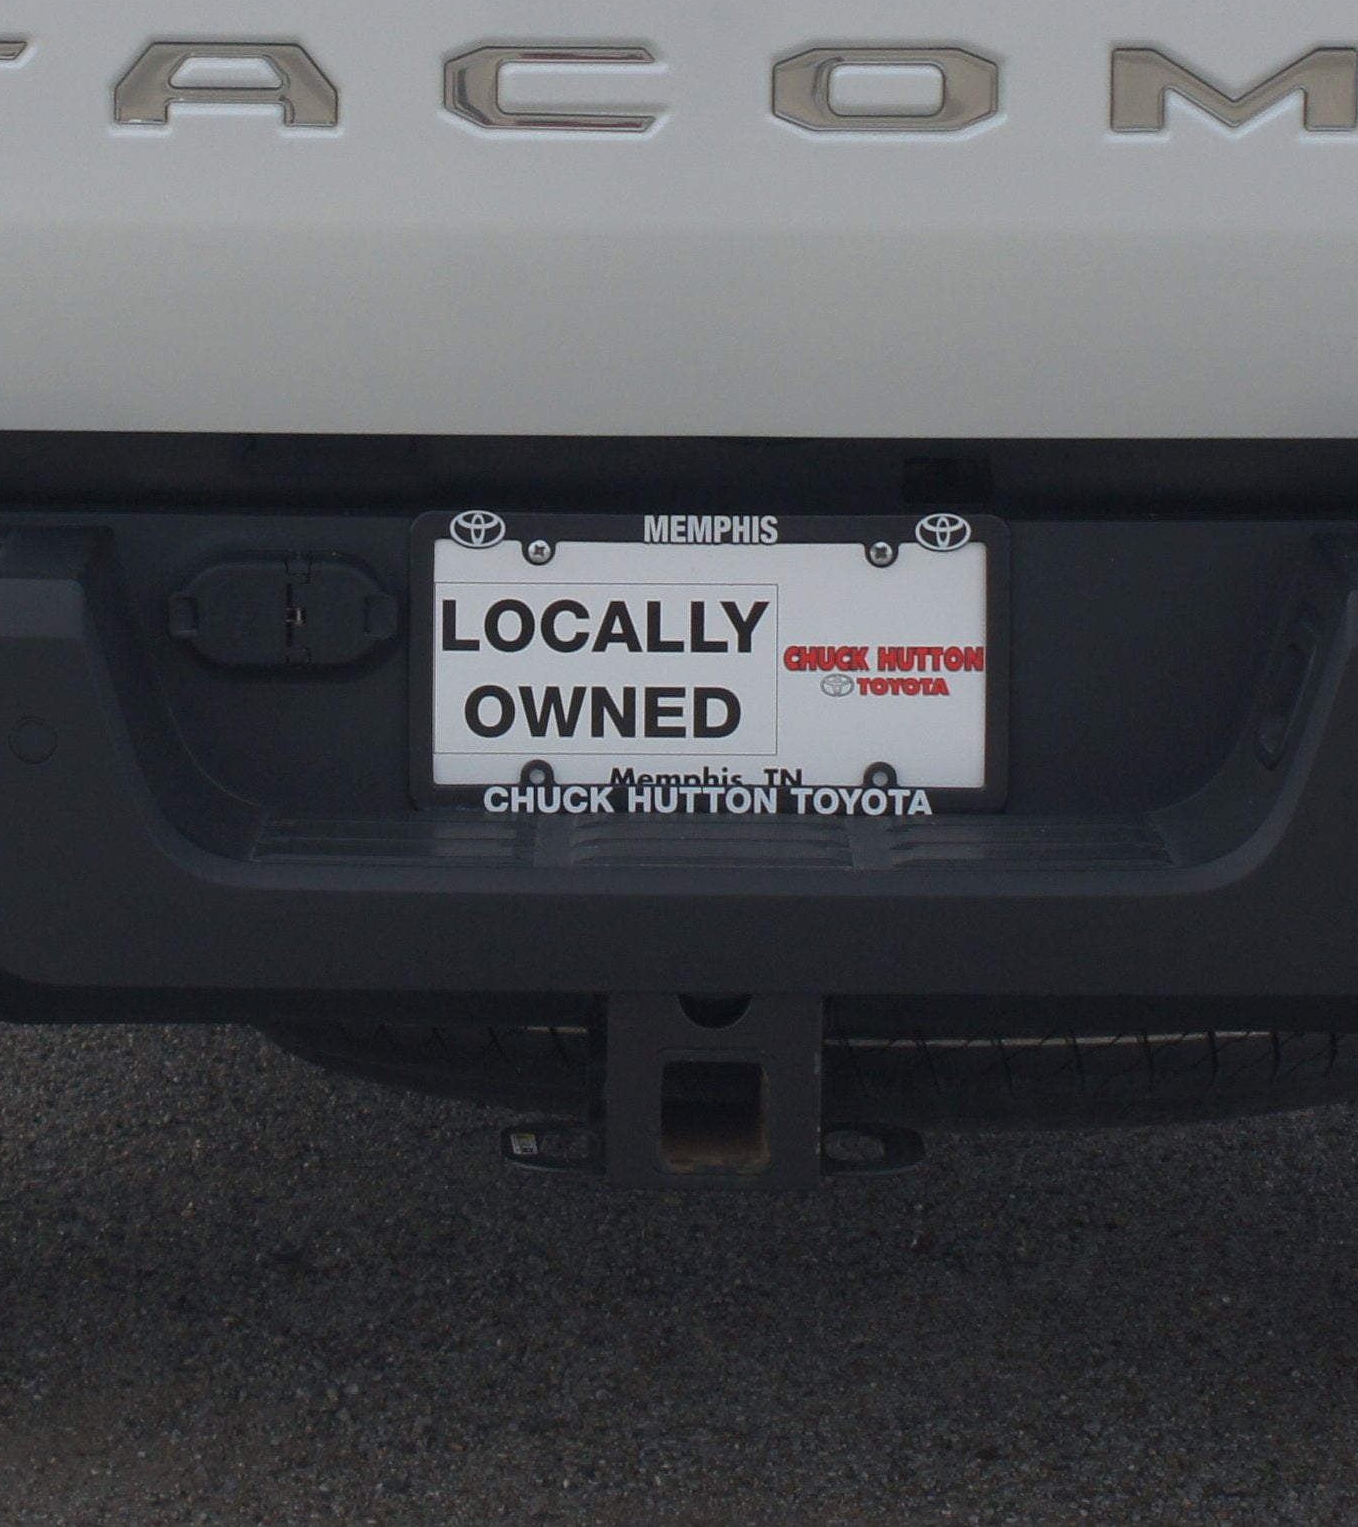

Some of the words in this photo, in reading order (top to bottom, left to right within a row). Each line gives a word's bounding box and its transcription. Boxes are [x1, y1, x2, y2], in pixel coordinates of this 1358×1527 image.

[643, 514, 779, 545] MEMPHIS
[442, 598, 770, 654] LOCALLY
[783, 645, 870, 672] CHUCK
[876, 645, 985, 672] HUTTON
[856, 677, 951, 696] TOYOTA
[463, 685, 742, 739] OWNED
[764, 768, 803, 786] TN
[483, 786, 615, 815] CHUCK
[627, 787, 778, 815] HUTTON
[790, 788, 933, 817] TOYOTA
